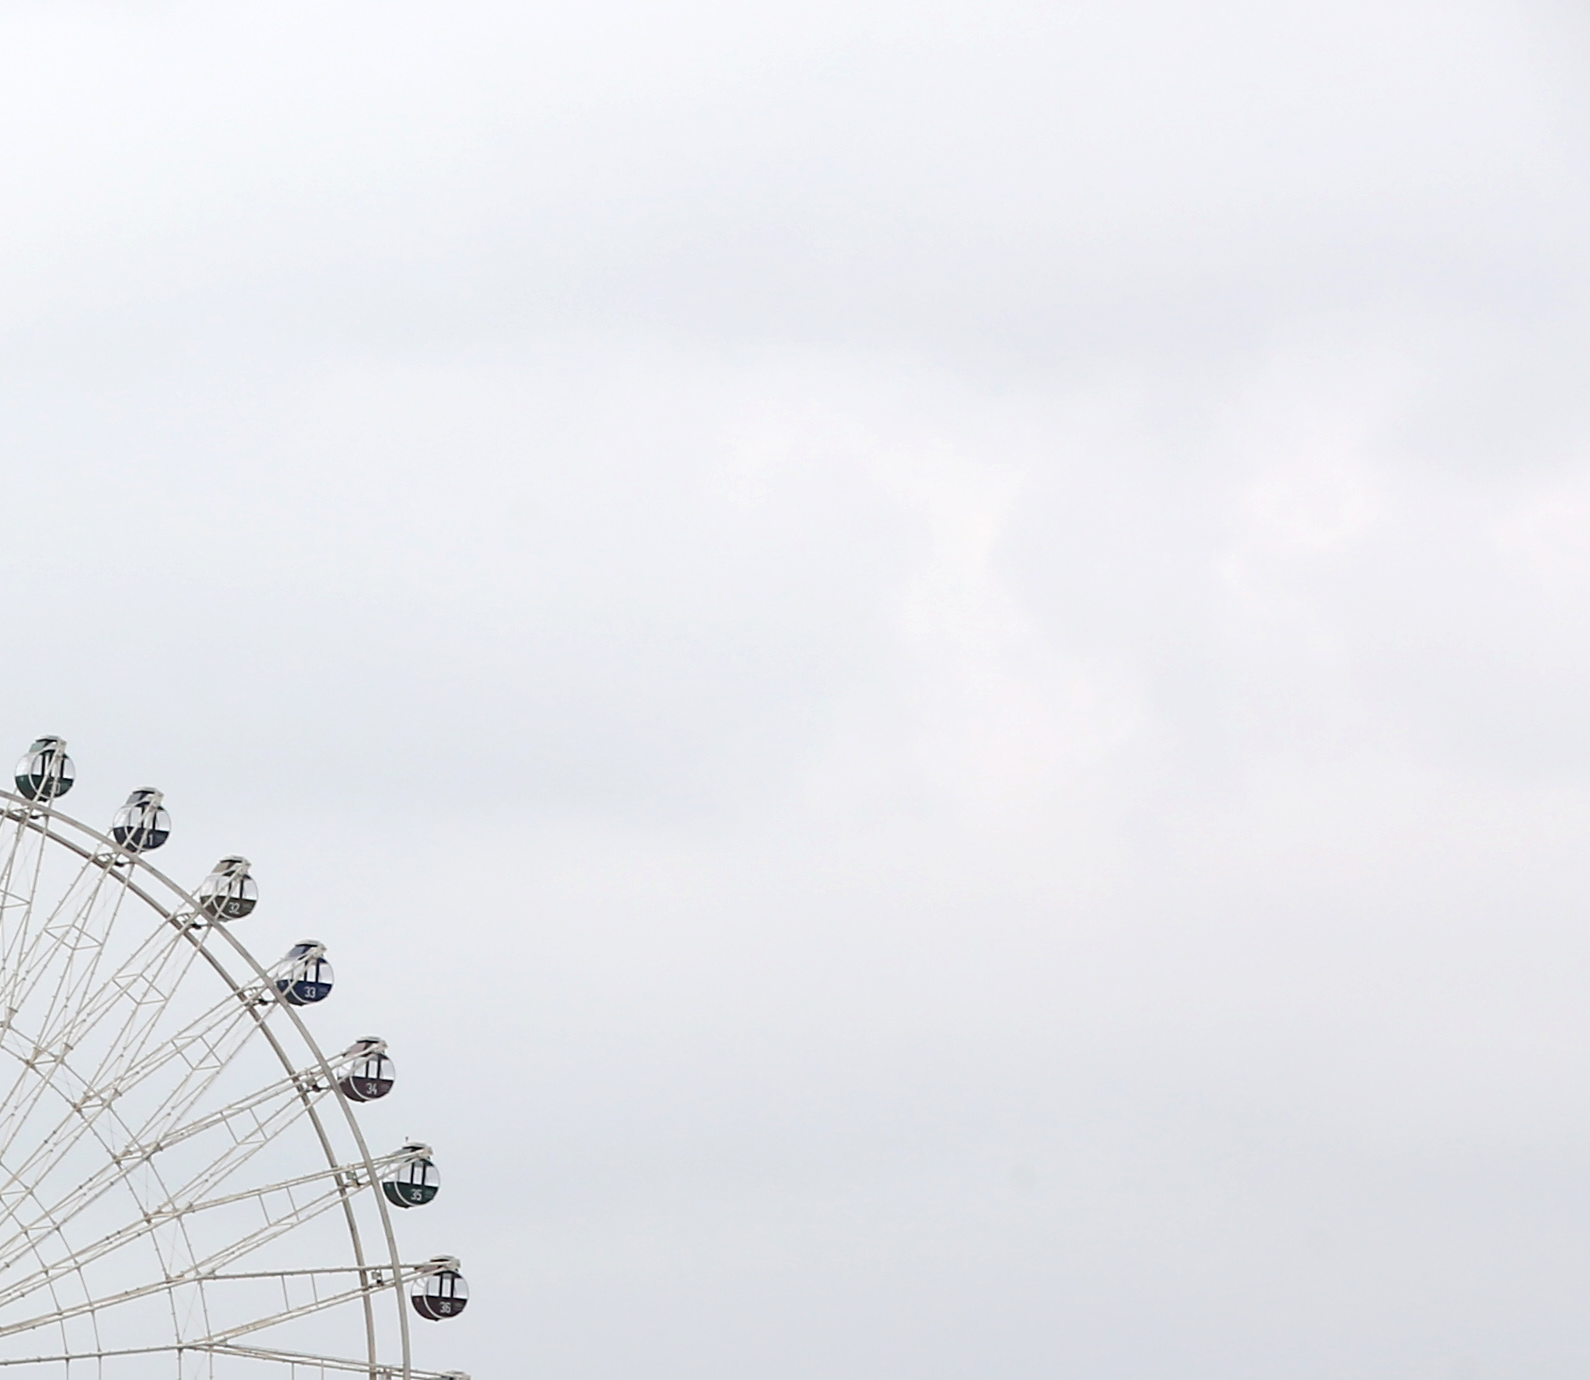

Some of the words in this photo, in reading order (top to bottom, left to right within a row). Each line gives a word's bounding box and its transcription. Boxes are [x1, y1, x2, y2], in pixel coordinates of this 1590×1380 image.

[229, 903, 240, 914] 32
[304, 987, 315, 998] 33
[366, 1082, 377, 1094] 34
[411, 1189, 422, 1200] 35
[440, 1301, 451, 1313] 36
